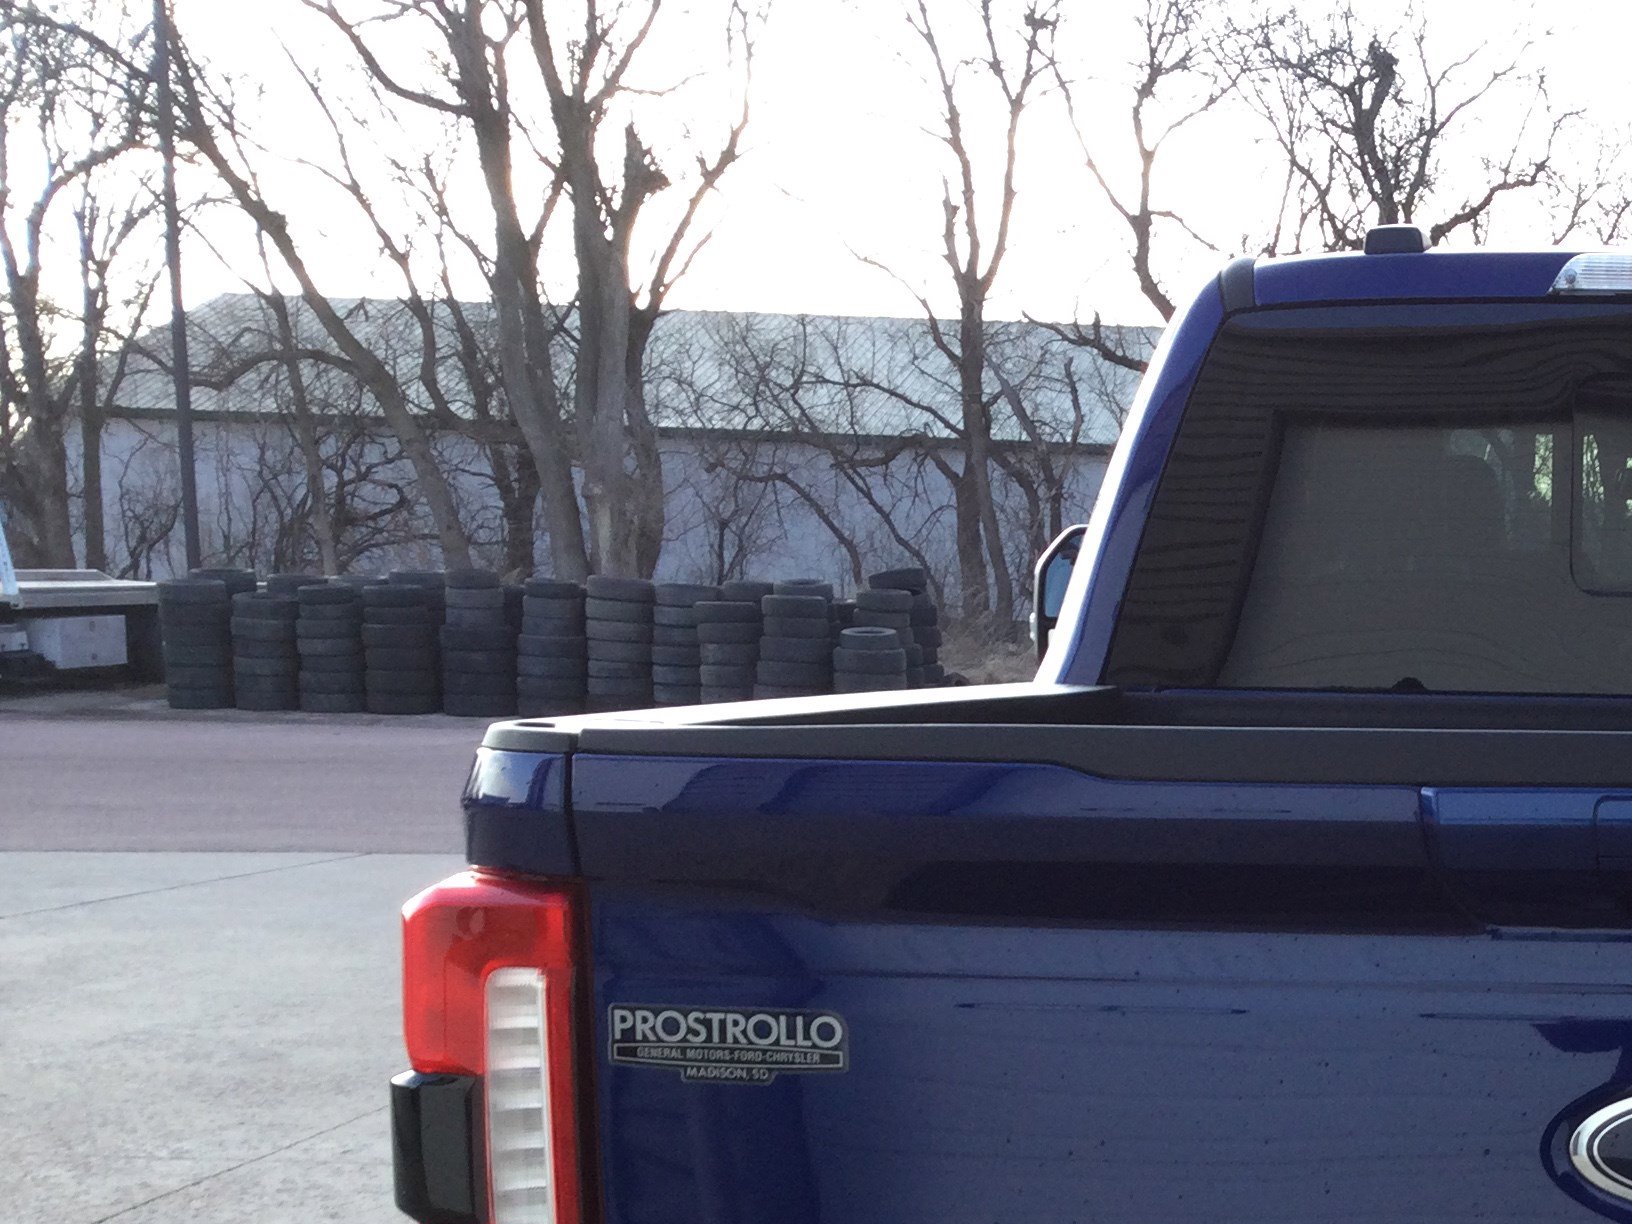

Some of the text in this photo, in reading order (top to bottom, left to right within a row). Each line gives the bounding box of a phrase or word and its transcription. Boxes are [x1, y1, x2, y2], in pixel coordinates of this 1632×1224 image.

[613, 1008, 843, 1048] PROSTROLLO
[636, 1047, 684, 1059] GENERAL
[752, 1068, 769, 1080] SD
